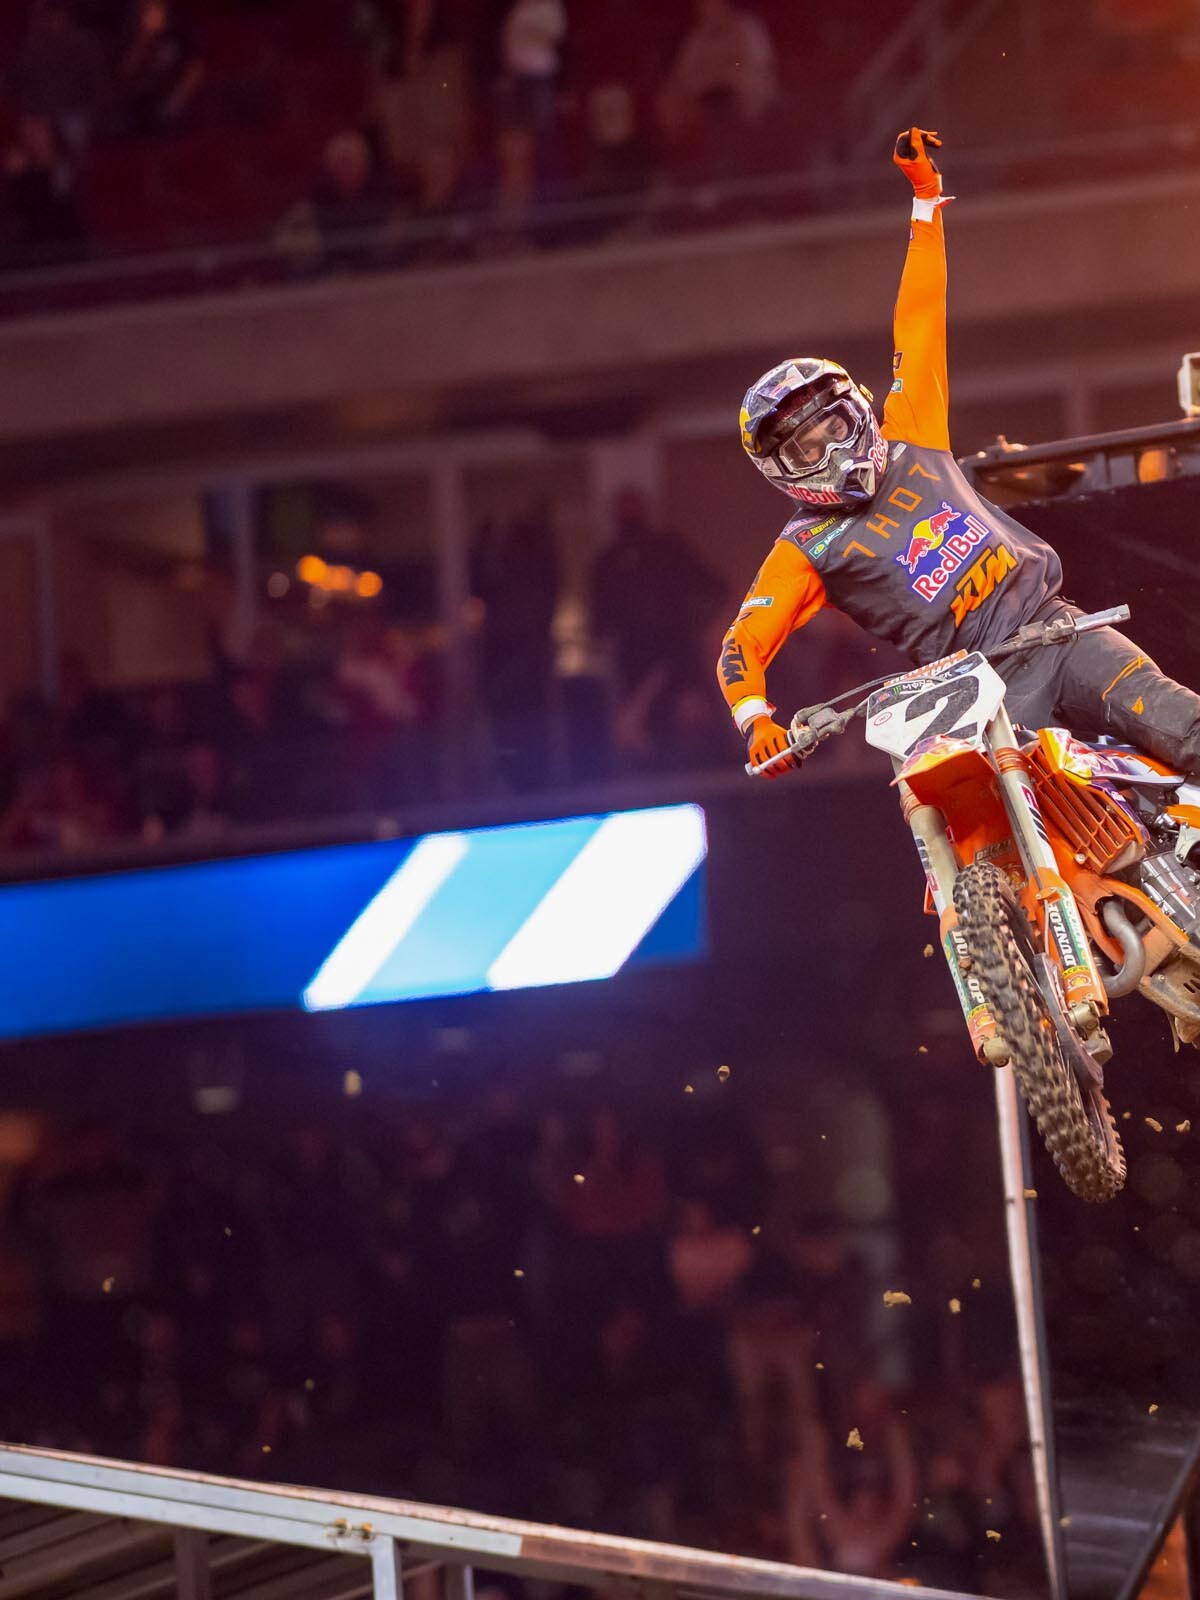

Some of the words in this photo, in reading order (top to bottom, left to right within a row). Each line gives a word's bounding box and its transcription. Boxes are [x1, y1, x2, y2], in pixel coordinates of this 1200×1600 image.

[912, 547, 962, 602] Red
[945, 514, 989, 560] Bull
[950, 544, 1018, 629] KTM
[722, 638, 748, 687] KTM
[905, 675, 979, 757] 2
